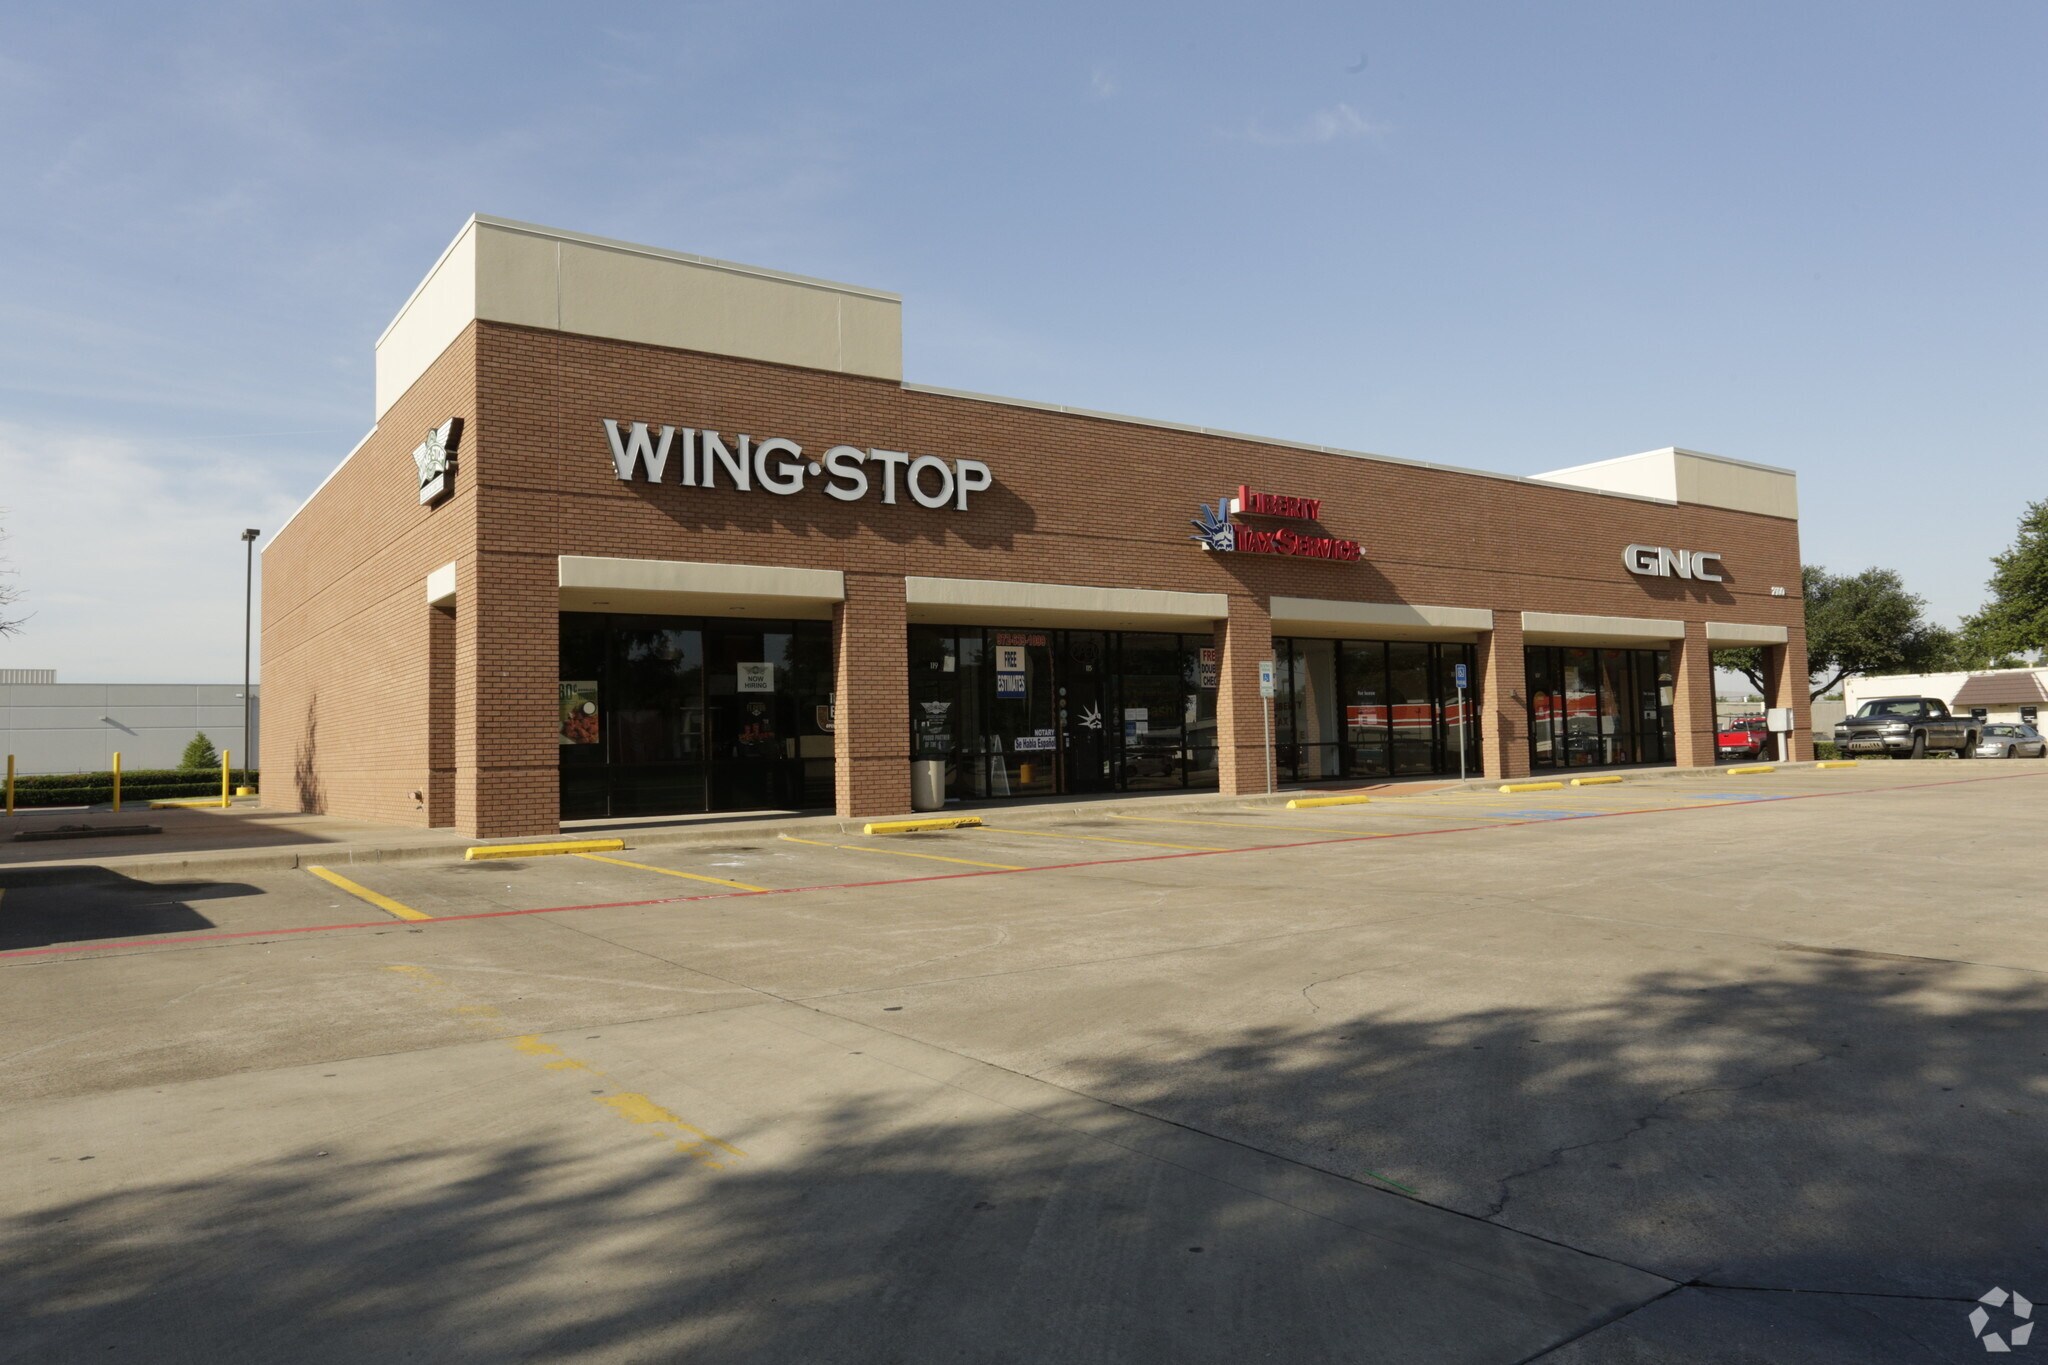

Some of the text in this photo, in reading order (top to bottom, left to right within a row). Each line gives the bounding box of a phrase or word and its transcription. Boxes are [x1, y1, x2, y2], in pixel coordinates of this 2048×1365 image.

[1239, 485, 1321, 519] LIBERTY
[1621, 543, 1722, 582] GNC
[1004, 651, 1017, 668] FREE
[1203, 650, 1216, 661] FRE
[1202, 664, 1216, 673] DOUB
[998, 675, 1025, 692] ESTIMATES
[1203, 676, 1217, 685] CHEC
[1016, 739, 1022, 749] Se
[1023, 738, 1036, 748] Habla
